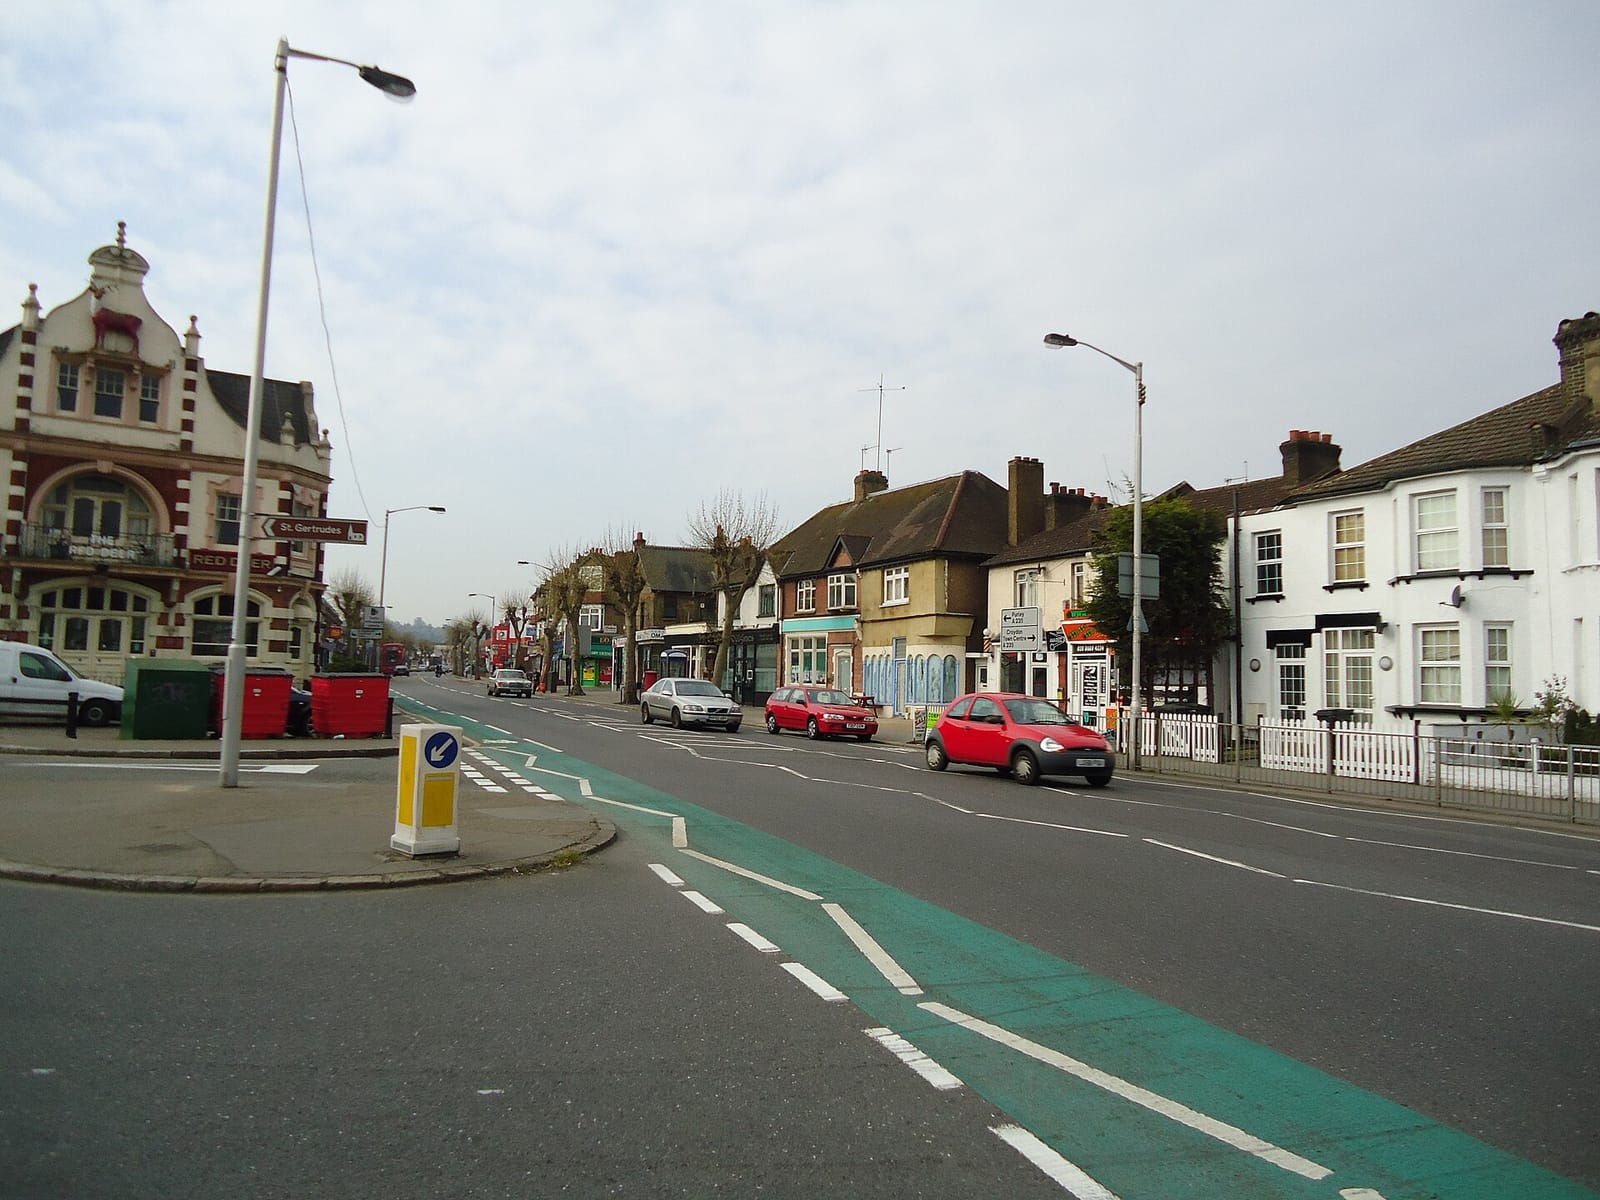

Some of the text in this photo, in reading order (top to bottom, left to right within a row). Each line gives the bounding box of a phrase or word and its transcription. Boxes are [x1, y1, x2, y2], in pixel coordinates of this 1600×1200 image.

[280, 522, 342, 535] St. Gertrudes
[90, 533, 114, 546] THE
[69, 545, 136, 559] RED DEER
[193, 554, 272, 569] RED DER
